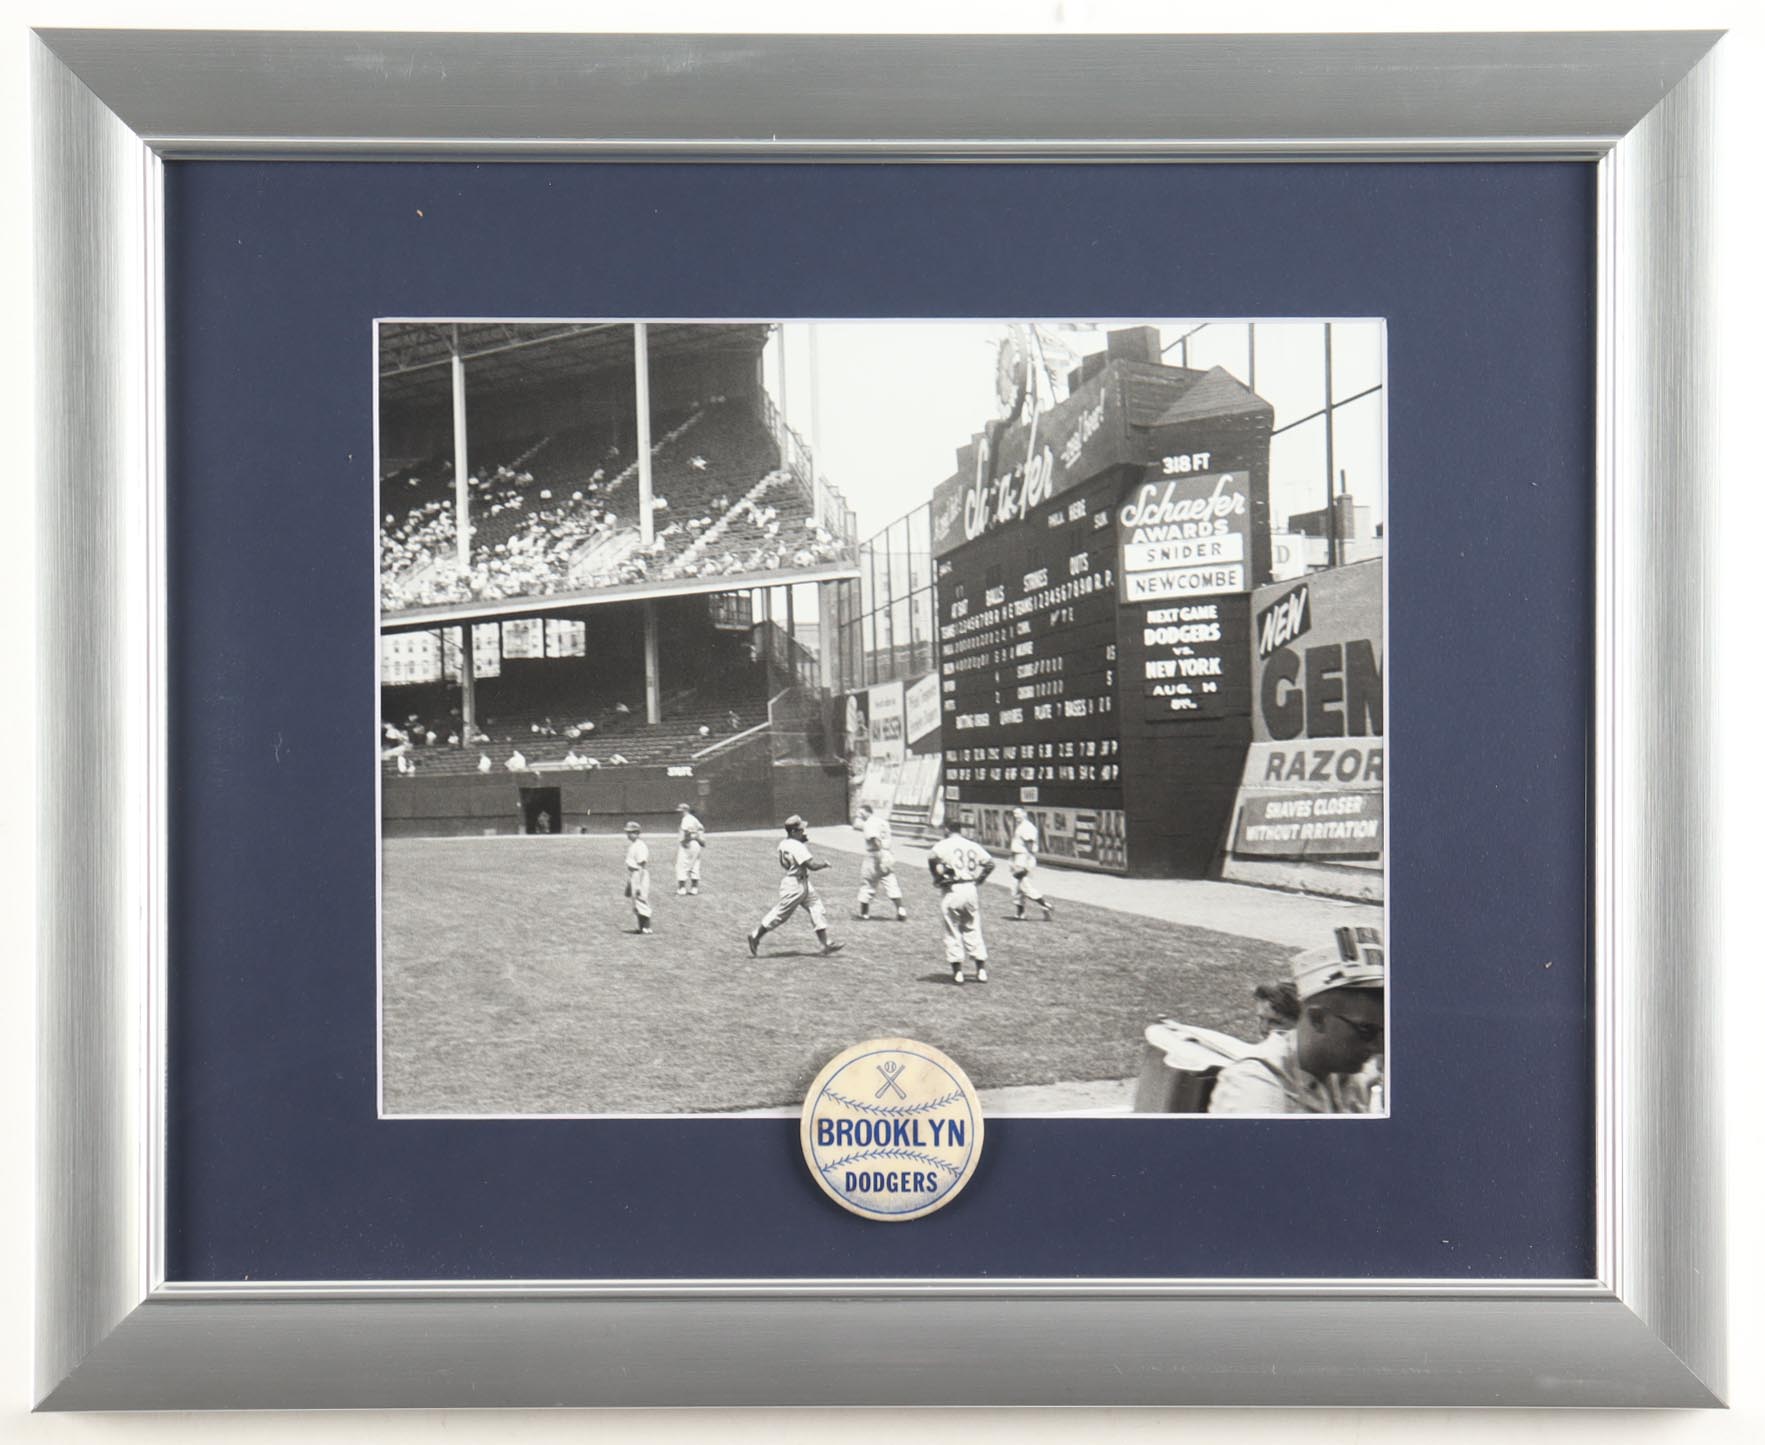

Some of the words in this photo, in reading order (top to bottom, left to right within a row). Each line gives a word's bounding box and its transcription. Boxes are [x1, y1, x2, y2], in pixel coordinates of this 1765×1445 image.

[1162, 455, 1191, 474] 318
[1192, 452, 1211, 471] FT
[1120, 474, 1246, 527] Schaefer
[1132, 518, 1229, 544] AWARDS
[1147, 542, 1222, 562] SNIDER
[1135, 570, 1237, 593] NEWCOMBE
[1147, 608, 1179, 624] NEXT
[1180, 605, 1218, 621] GAME
[1260, 587, 1308, 655] NEW
[1144, 623, 1221, 646] DODGERS
[1145, 660, 1177, 679] NEW
[1178, 657, 1222, 677] YORK
[1152, 684, 1192, 696] AUG.
[1261, 638, 1384, 740] GEN
[1264, 748, 1384, 782] RAZOR
[1265, 800, 1313, 819] SHAVES
[1314, 796, 1364, 816] CLOSER
[1246, 823, 1300, 841] WITHOUT
[1301, 819, 1379, 839] IRRITATION
[953, 848, 977, 872] 38
[817, 1117, 965, 1147] BROOKLYN
[845, 1171, 938, 1193] DODGERS
